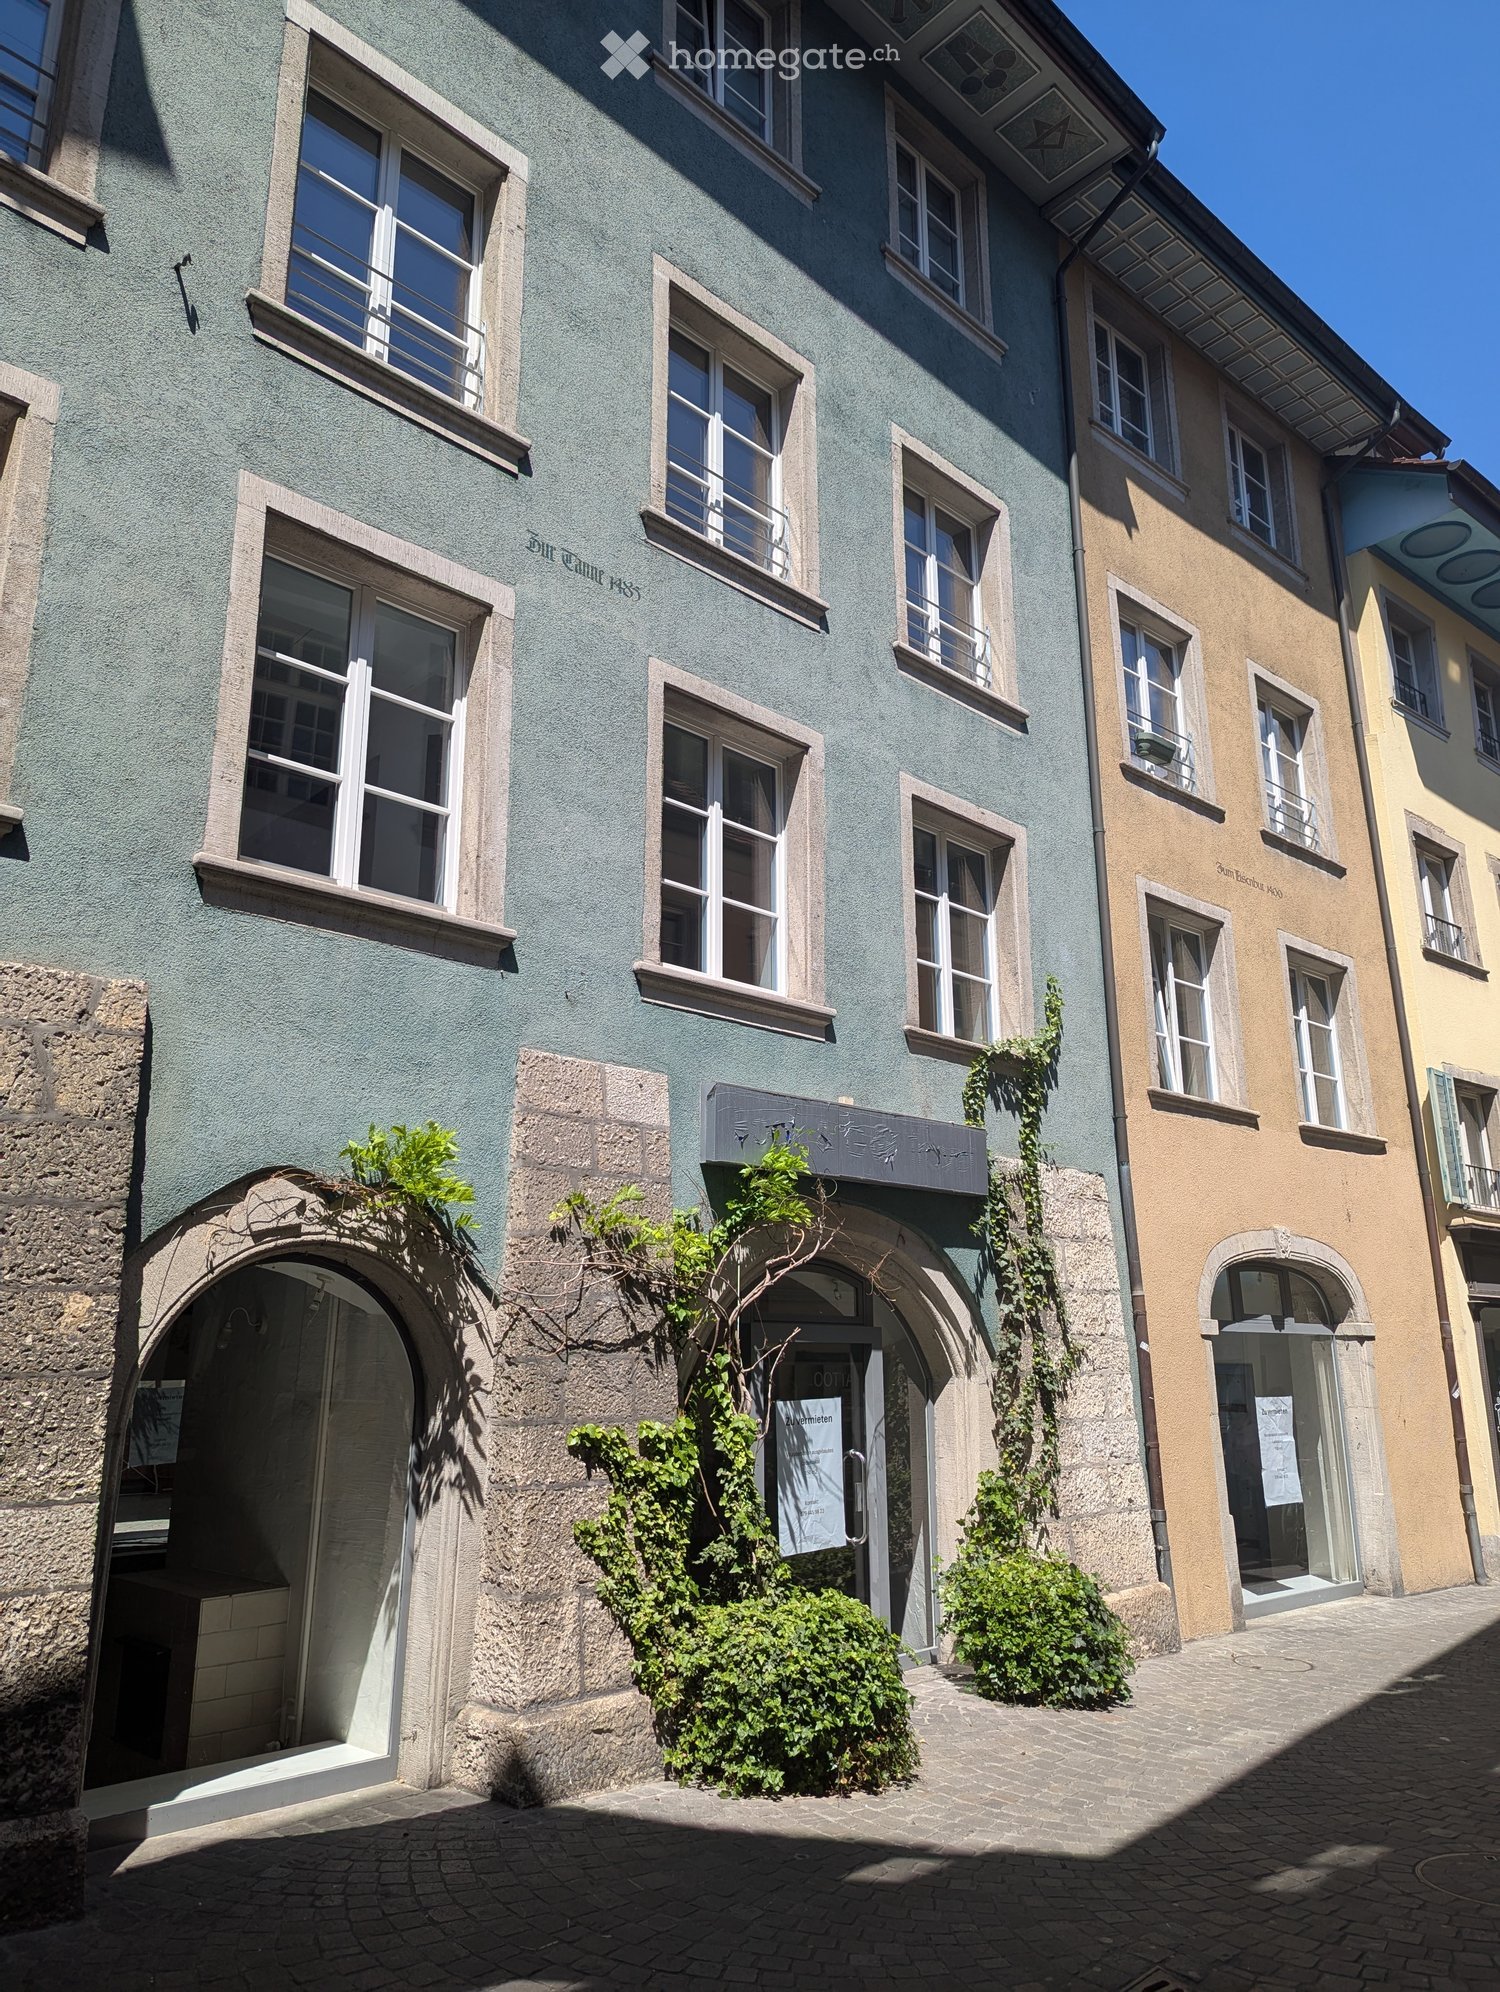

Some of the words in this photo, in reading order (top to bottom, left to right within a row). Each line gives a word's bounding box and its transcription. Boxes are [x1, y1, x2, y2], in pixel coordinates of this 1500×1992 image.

[1215, 861, 1235, 880] Zum
[785, 1416, 795, 1426] Zu
[795, 1414, 833, 1426] vermieten
